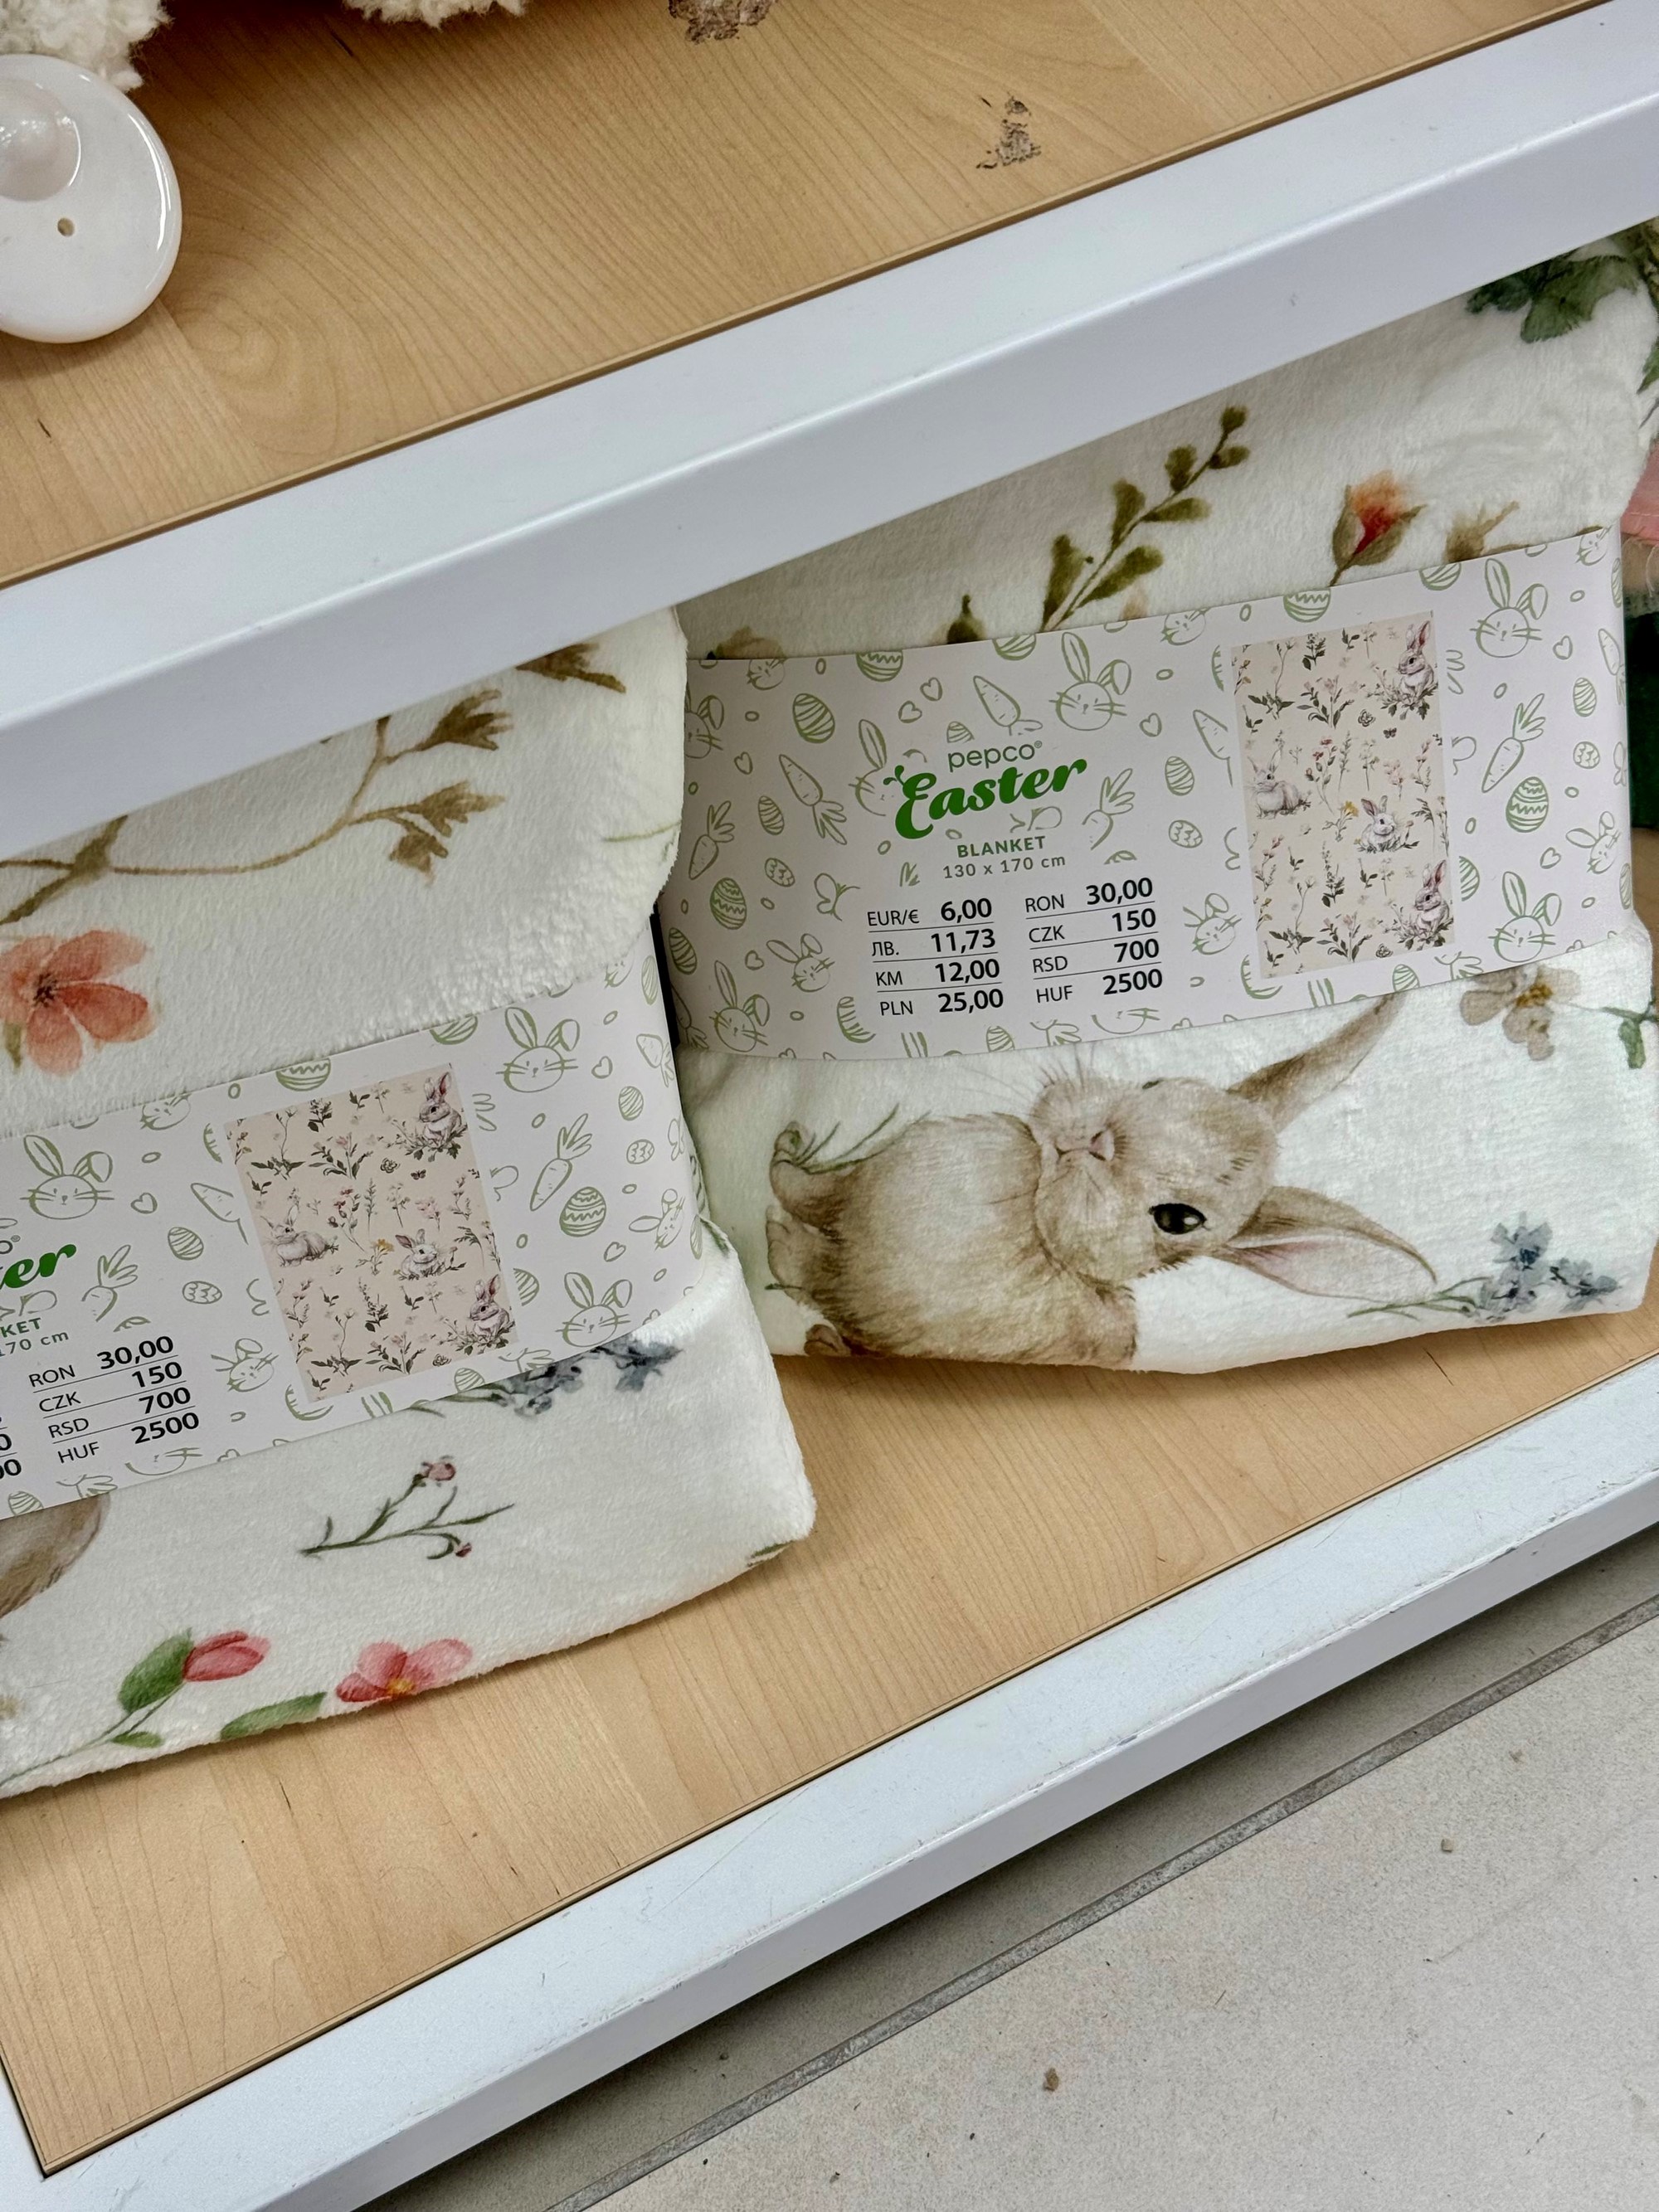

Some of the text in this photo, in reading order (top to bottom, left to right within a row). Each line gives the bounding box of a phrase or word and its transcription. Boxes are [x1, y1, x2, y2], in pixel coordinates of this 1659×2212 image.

[883, 758, 1088, 840] Easter
[956, 835, 1047, 858] BLANKET
[942, 855, 1066, 879] 130 x 170 cm
[867, 897, 993, 926] EUR/€ 6,00
[1024, 877, 1153, 913] RON 30,00
[930, 927, 996, 953] 11,73
[1028, 907, 1156, 943] CZK 150
[875, 958, 1000, 987] KM 12,00
[1032, 937, 1160, 974] RSD 700
[879, 987, 1005, 1016] PLN 25,00
[1035, 968, 1163, 1004] HUF 2500
[0, 1331, 70, 1358] 70 cm
[28, 1334, 174, 1388] RON 30,00
[38, 1361, 182, 1412] CZK 150
[47, 1386, 191, 1439] RSD 700
[57, 1412, 200, 1464] HUF 2500
